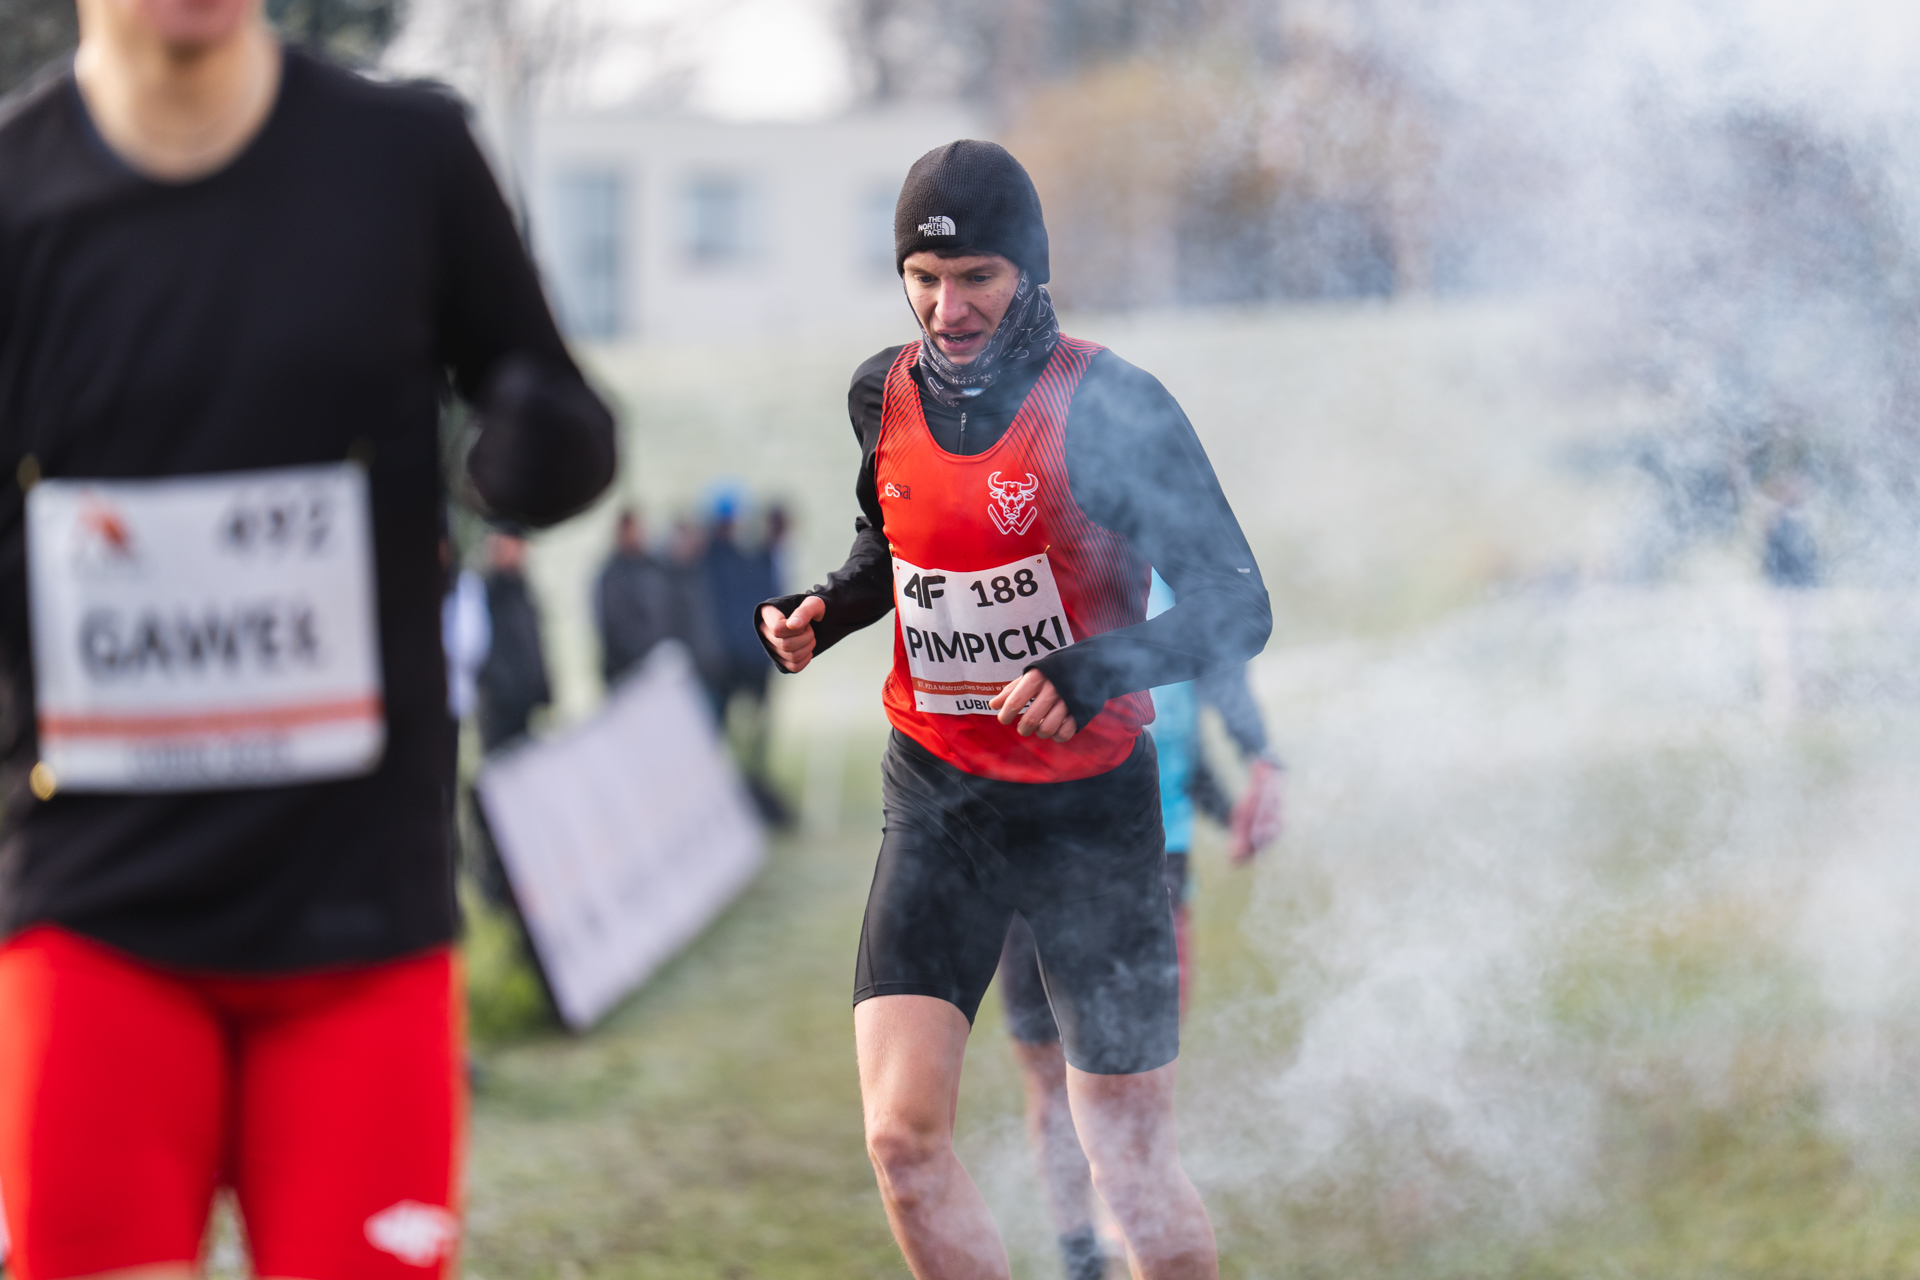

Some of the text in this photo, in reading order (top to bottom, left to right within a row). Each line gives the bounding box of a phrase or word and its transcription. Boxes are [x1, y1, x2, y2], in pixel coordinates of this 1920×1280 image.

[918, 222, 942, 231] NORTH
[924, 229, 942, 237] FACE
[903, 568, 1039, 609] 4F 188
[905, 615, 1067, 663] PIMPICKI
